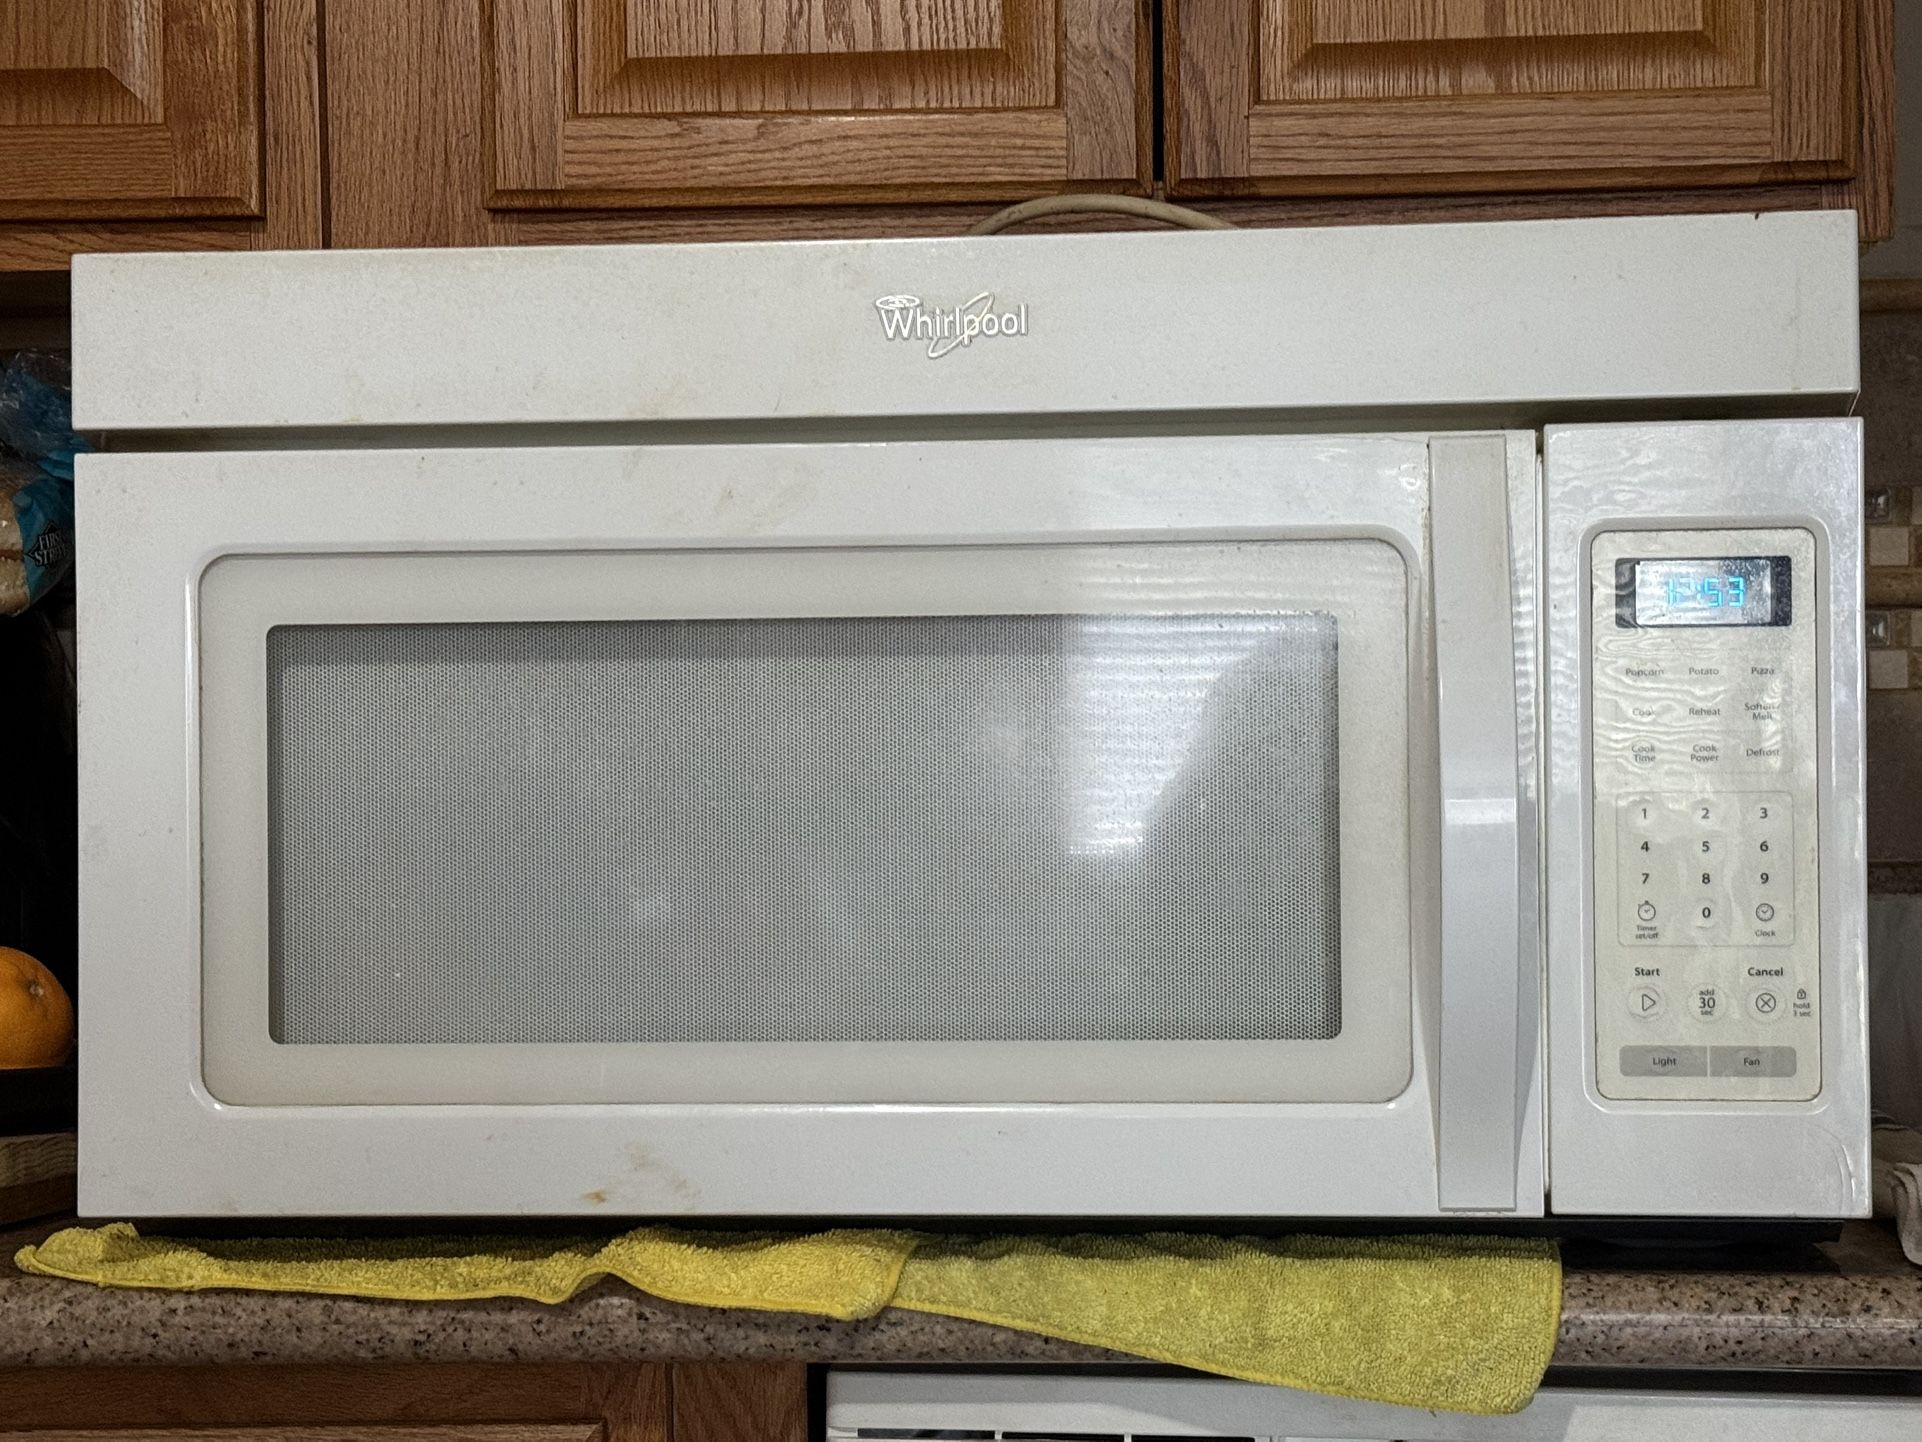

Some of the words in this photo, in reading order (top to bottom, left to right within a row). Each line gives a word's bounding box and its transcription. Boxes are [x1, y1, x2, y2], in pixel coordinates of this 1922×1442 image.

[878, 300, 1028, 348] Whirlpool
[1625, 667, 1665, 677] Popcorn
[1688, 667, 1720, 675] Potato
[1751, 666, 1775, 675] Pizza
[1688, 706, 1721, 716] Reheat
[1631, 744, 1655, 753] Cook
[1692, 743, 1718, 752] Cook
[1746, 748, 1780, 757] Defrost
[1634, 754, 1656, 763] Time
[1690, 753, 1719, 762] Power
[1641, 808, 1648, 819] 1
[1701, 807, 1710, 819] 2
[1759, 807, 1768, 819] 3
[1640, 841, 1650, 852] 4
[1701, 841, 1710, 852] 5
[1759, 841, 1769, 852] 6
[1641, 873, 1650, 884] 7
[1701, 873, 1711, 884] 8
[1760, 873, 1769, 884] 9
[1702, 907, 1711, 918] 0
[1754, 929, 1776, 937] Clock
[1634, 967, 1661, 976] Start
[1747, 967, 1784, 977] Cancel
[1698, 997, 1716, 1009] 30
[1652, 1057, 1677, 1067] Light
[1743, 1057, 1761, 1066] Fan
